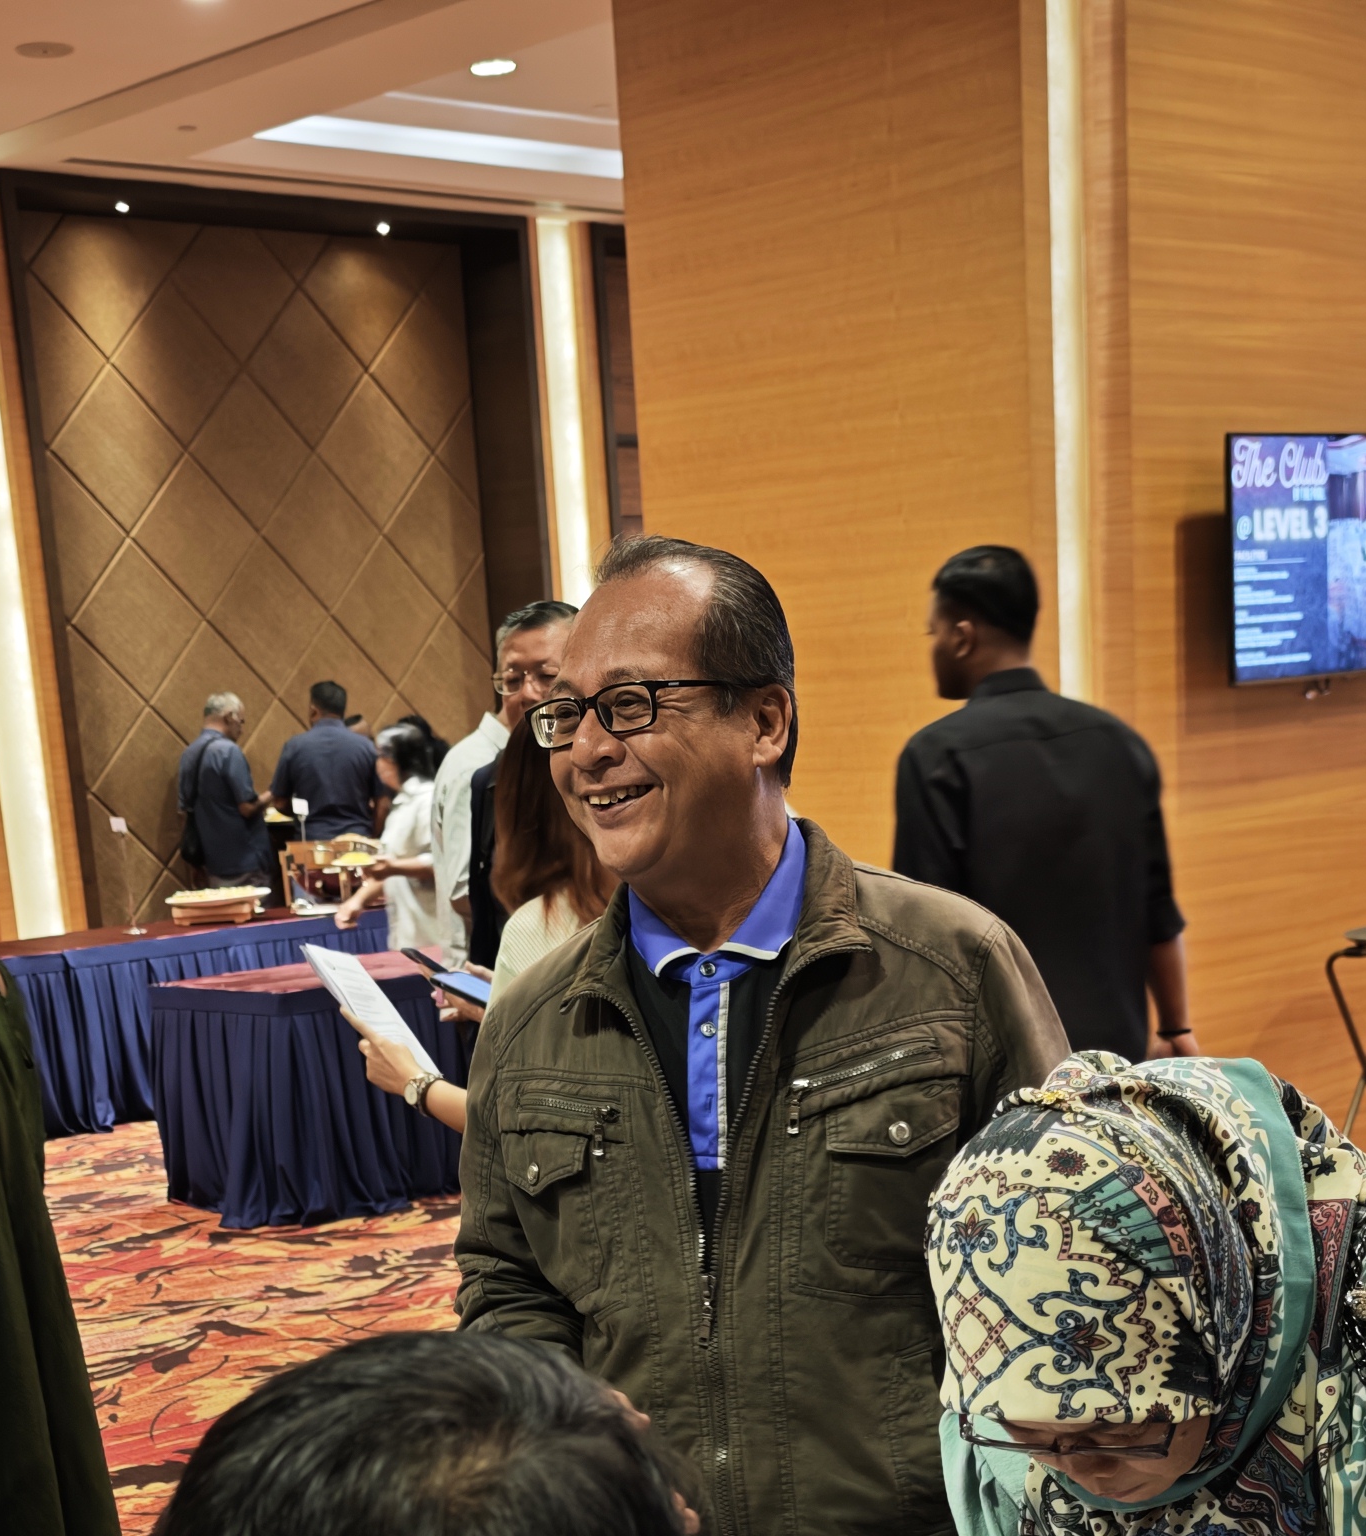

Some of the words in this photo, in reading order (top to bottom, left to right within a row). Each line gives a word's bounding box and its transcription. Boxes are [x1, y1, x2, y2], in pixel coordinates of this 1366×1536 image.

[1232, 439, 1278, 489] The
[1279, 441, 1329, 489] Club
[1314, 505, 1328, 540] 3
